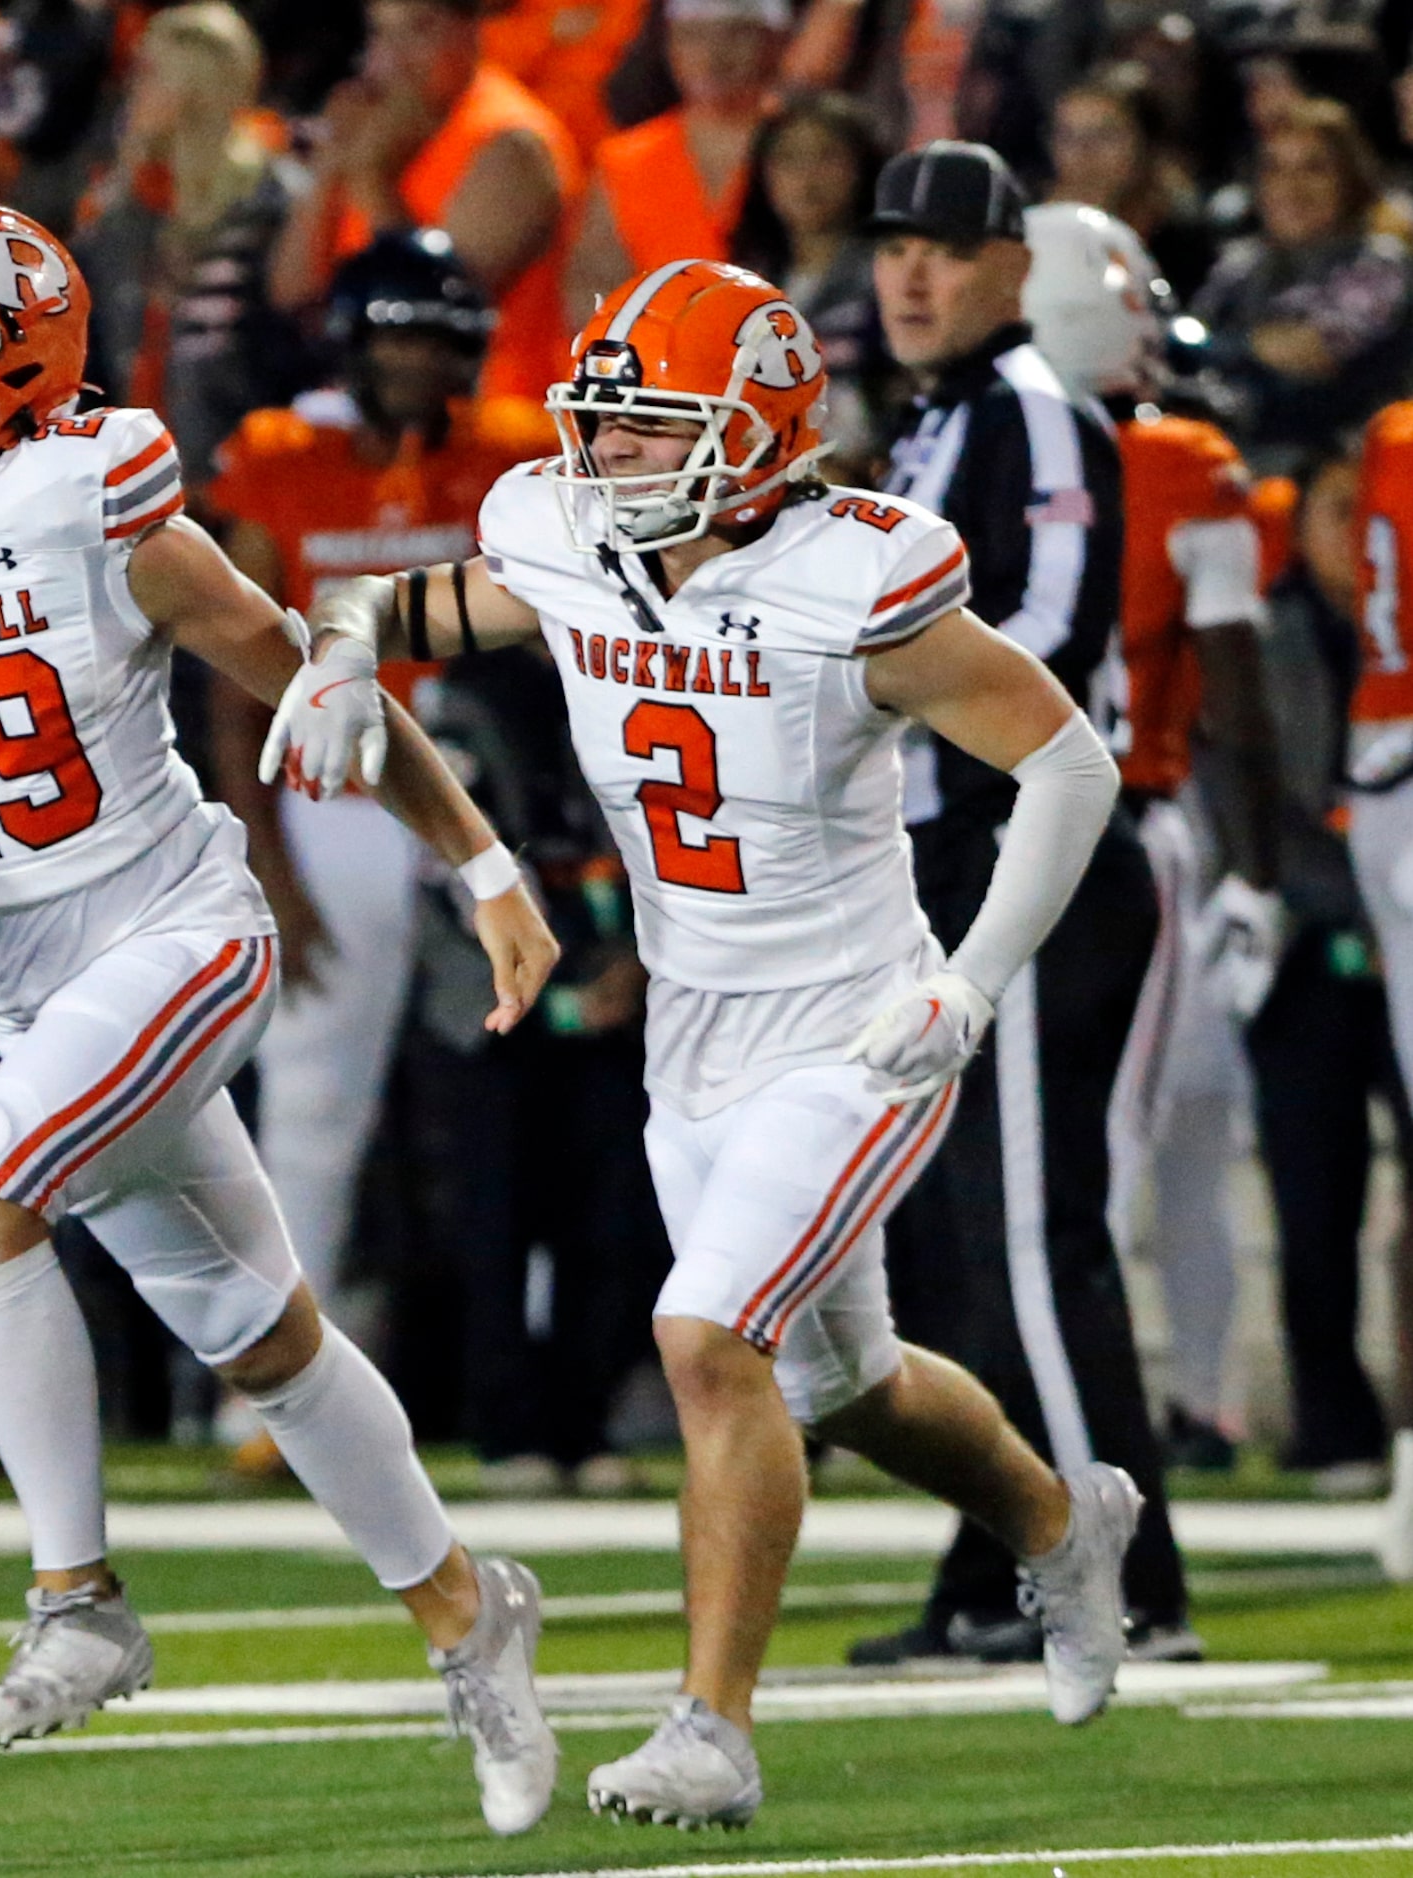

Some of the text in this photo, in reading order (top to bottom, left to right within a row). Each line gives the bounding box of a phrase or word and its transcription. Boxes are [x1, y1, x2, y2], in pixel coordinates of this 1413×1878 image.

[828, 497, 910, 534] 2
[568, 627, 771, 698] ROCKWALL
[622, 698, 748, 895] 2
